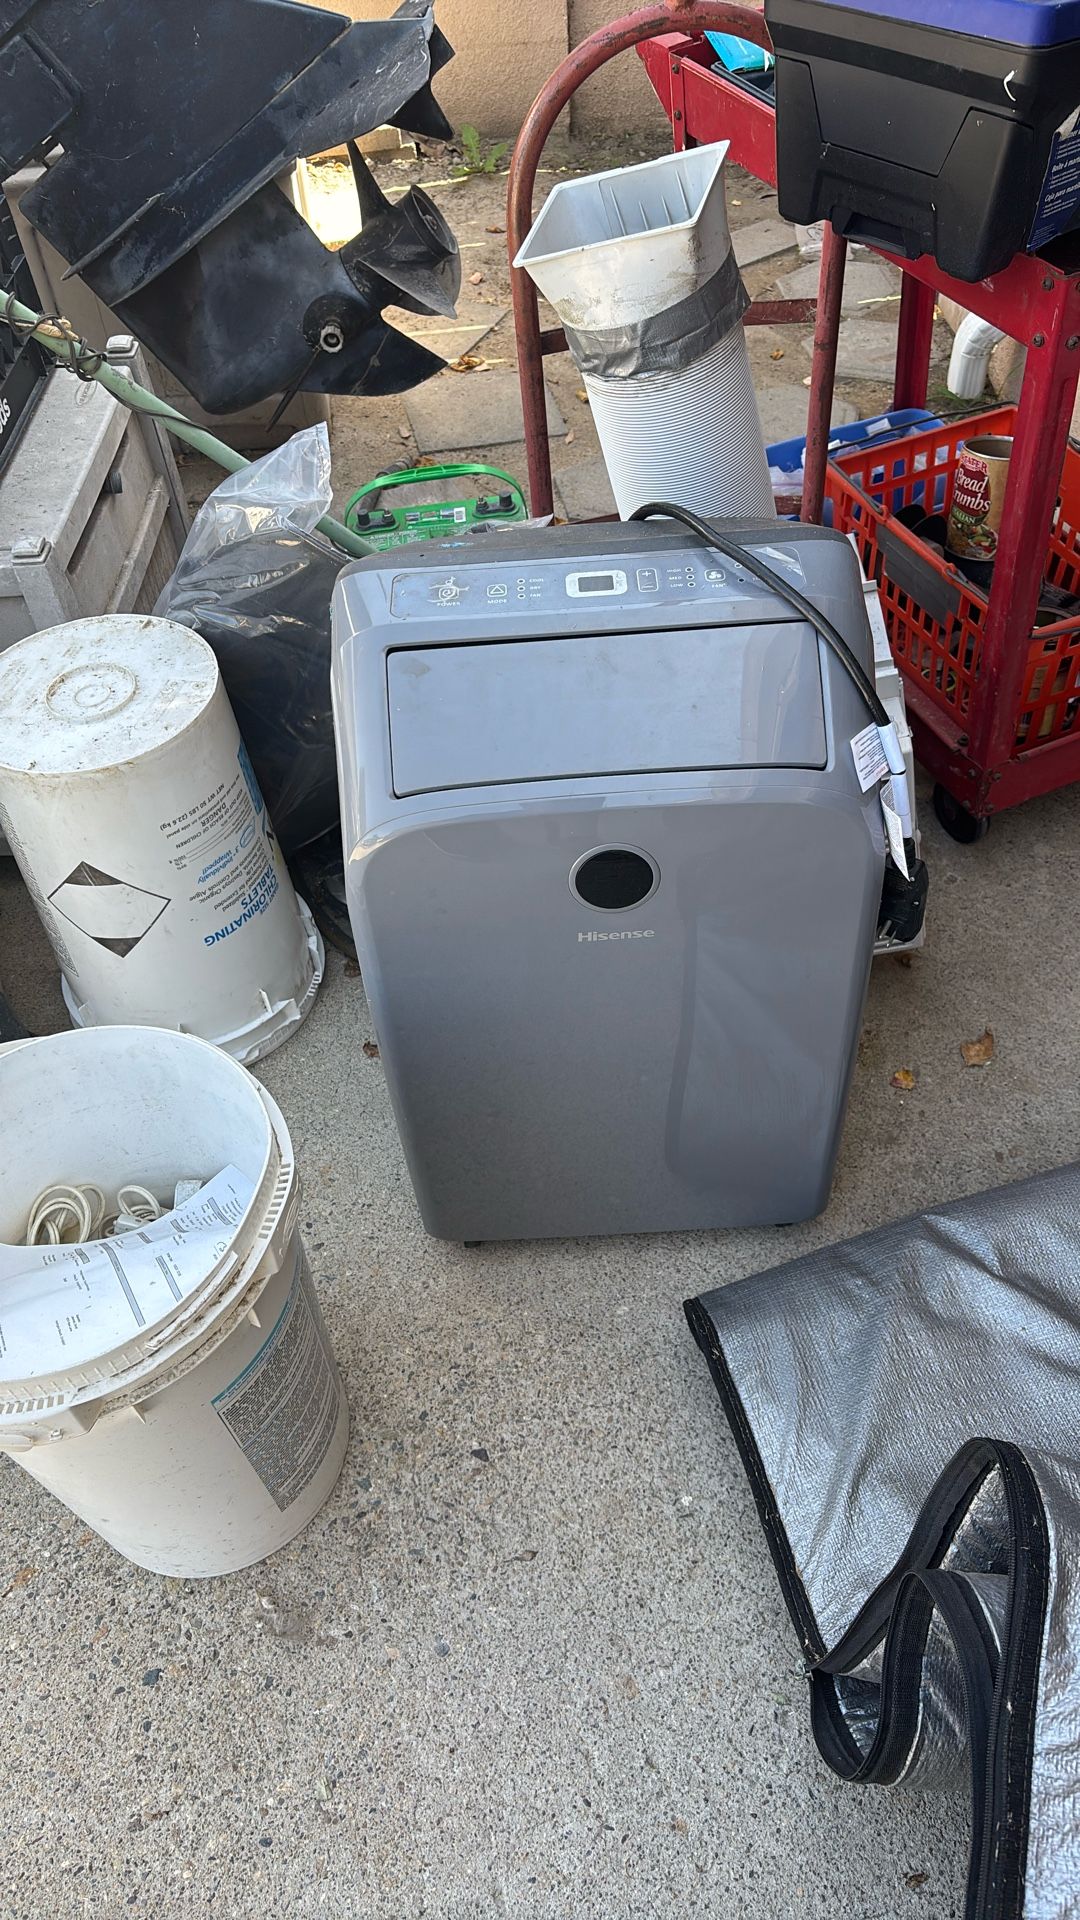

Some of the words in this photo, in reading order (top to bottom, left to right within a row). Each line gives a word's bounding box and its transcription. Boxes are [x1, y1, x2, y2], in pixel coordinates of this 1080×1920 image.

[957, 468, 989, 493] Bread
[216, 783, 225, 795] NET
[199, 800, 207, 809] 50
[207, 793, 215, 802] WT
[188, 806, 199, 816] LBS
[200, 802, 226, 827] DANGER
[160, 822, 171, 831] kg)
[172, 813, 188, 826] (22.6
[210, 813, 224, 828] REACH
[166, 828, 180, 839] panel
[176, 832, 202, 849] CHILDREN
[207, 875, 230, 891] Controls
[222, 871, 243, 890] Destroys
[241, 864, 273, 910] TABLETS
[188, 890, 207, 903] Algae
[199, 889, 221, 904] Organic
[214, 890, 238, 910] Extended
[204, 874, 277, 947] CHLORINATING
[578, 929, 655, 942] Hisense
